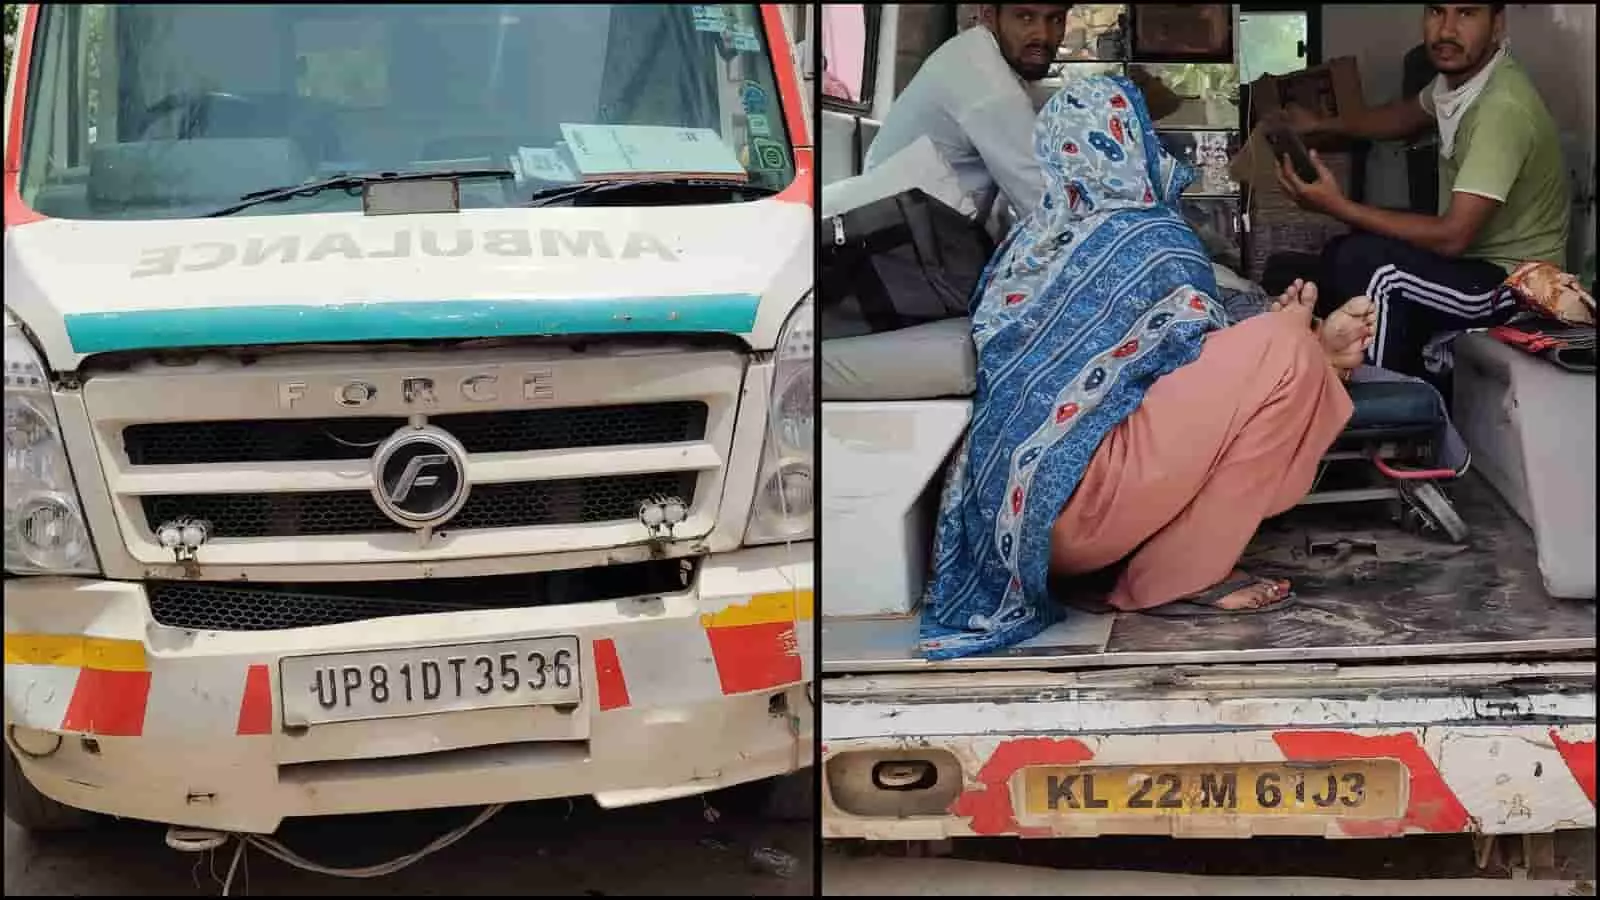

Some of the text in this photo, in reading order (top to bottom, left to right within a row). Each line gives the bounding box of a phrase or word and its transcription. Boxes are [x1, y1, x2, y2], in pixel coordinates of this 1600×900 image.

[279, 370, 555, 410] FORCE
[316, 650, 572, 708] UP81DT3536
[1047, 774, 1109, 810] KL
[1127, 773, 1183, 809] 22
[1201, 773, 1238, 809] M
